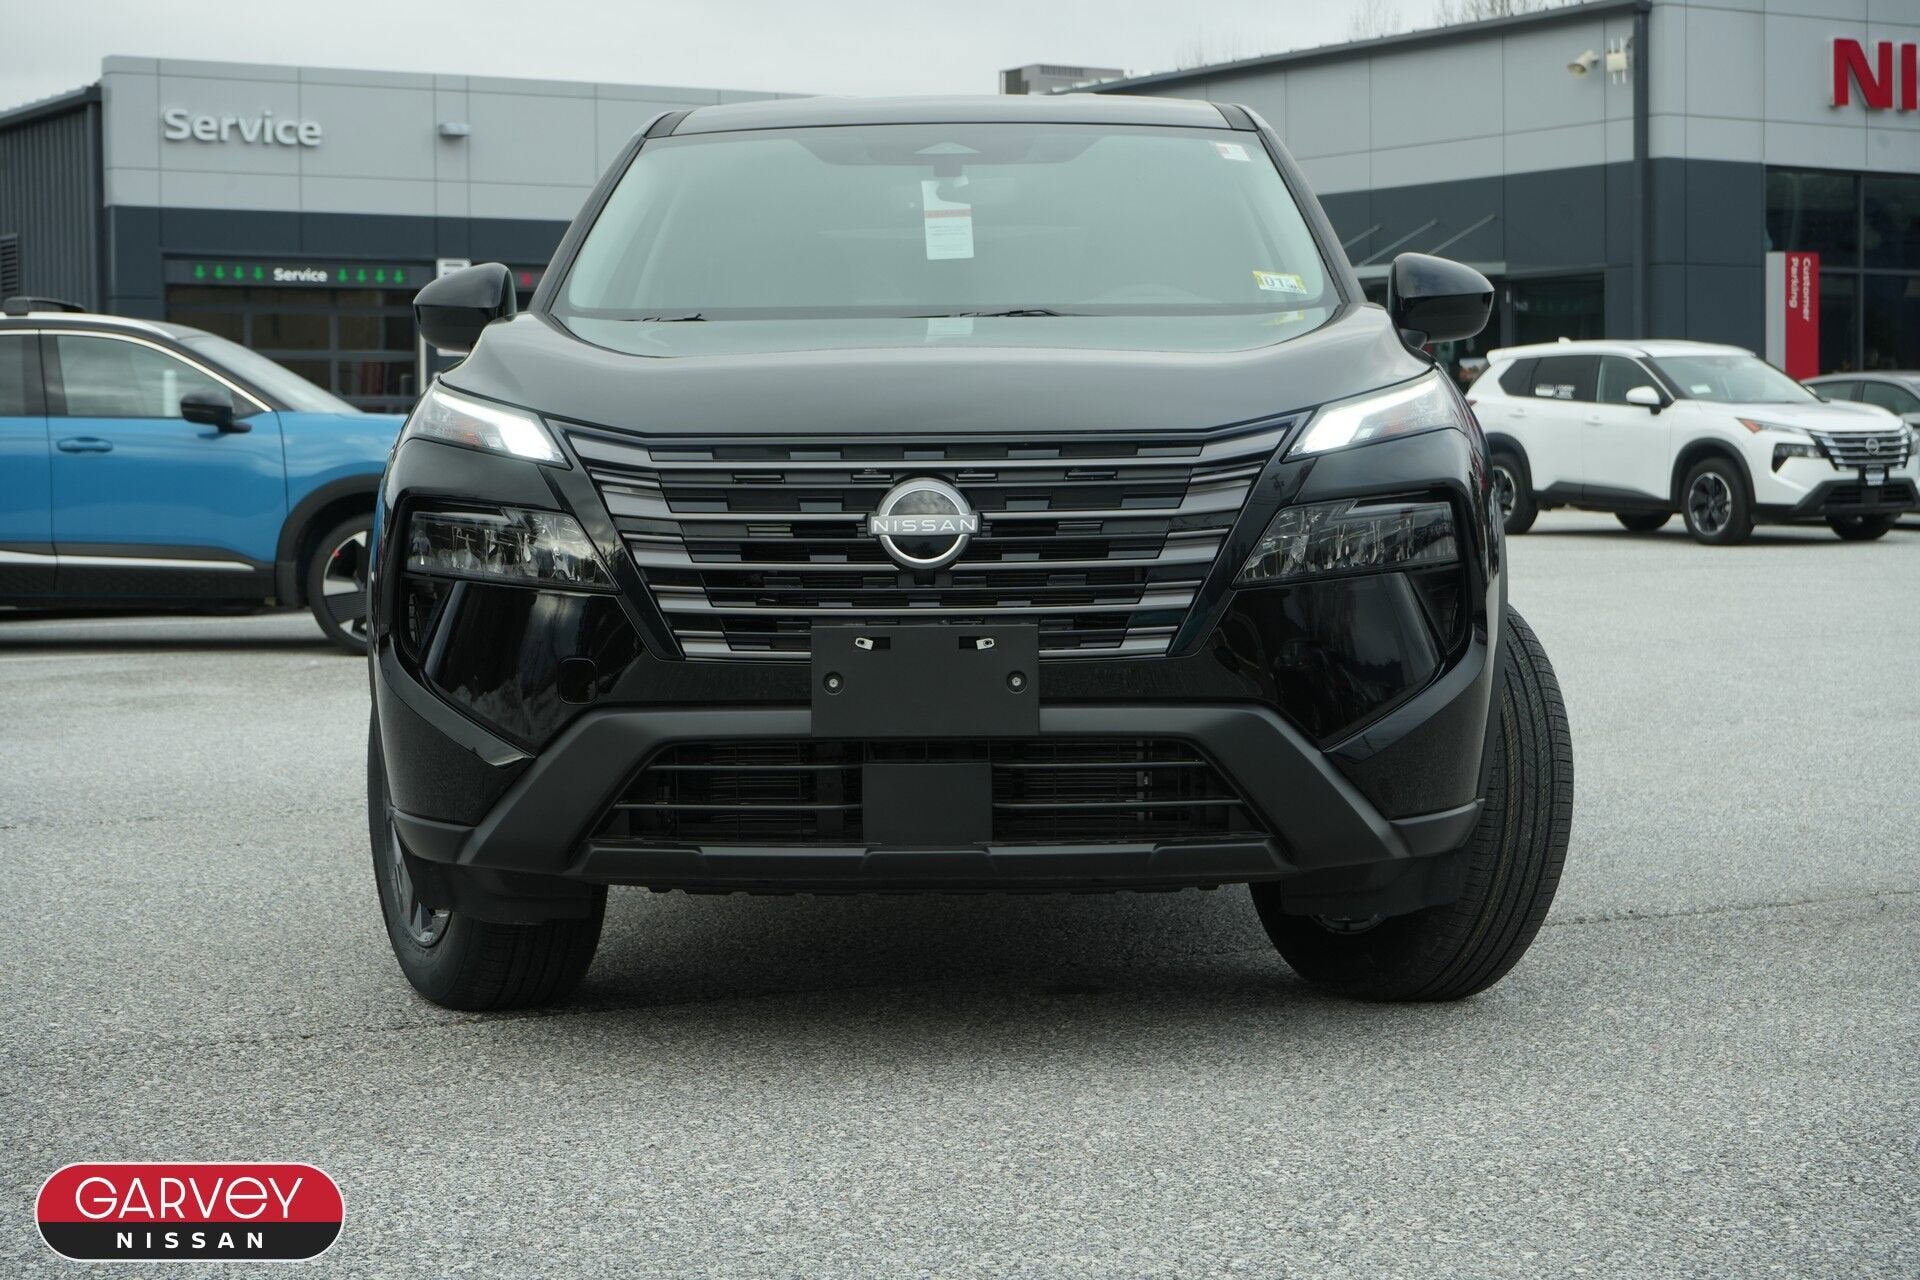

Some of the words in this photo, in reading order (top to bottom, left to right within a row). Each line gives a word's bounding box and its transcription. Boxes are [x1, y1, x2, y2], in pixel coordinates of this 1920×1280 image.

[1832, 38, 1917, 110] NI
[164, 108, 322, 146] Service
[273, 267, 328, 282] Service
[1789, 257, 1799, 308] Parking
[1803, 257, 1811, 321] Customer
[874, 519, 976, 532] NISSAN
